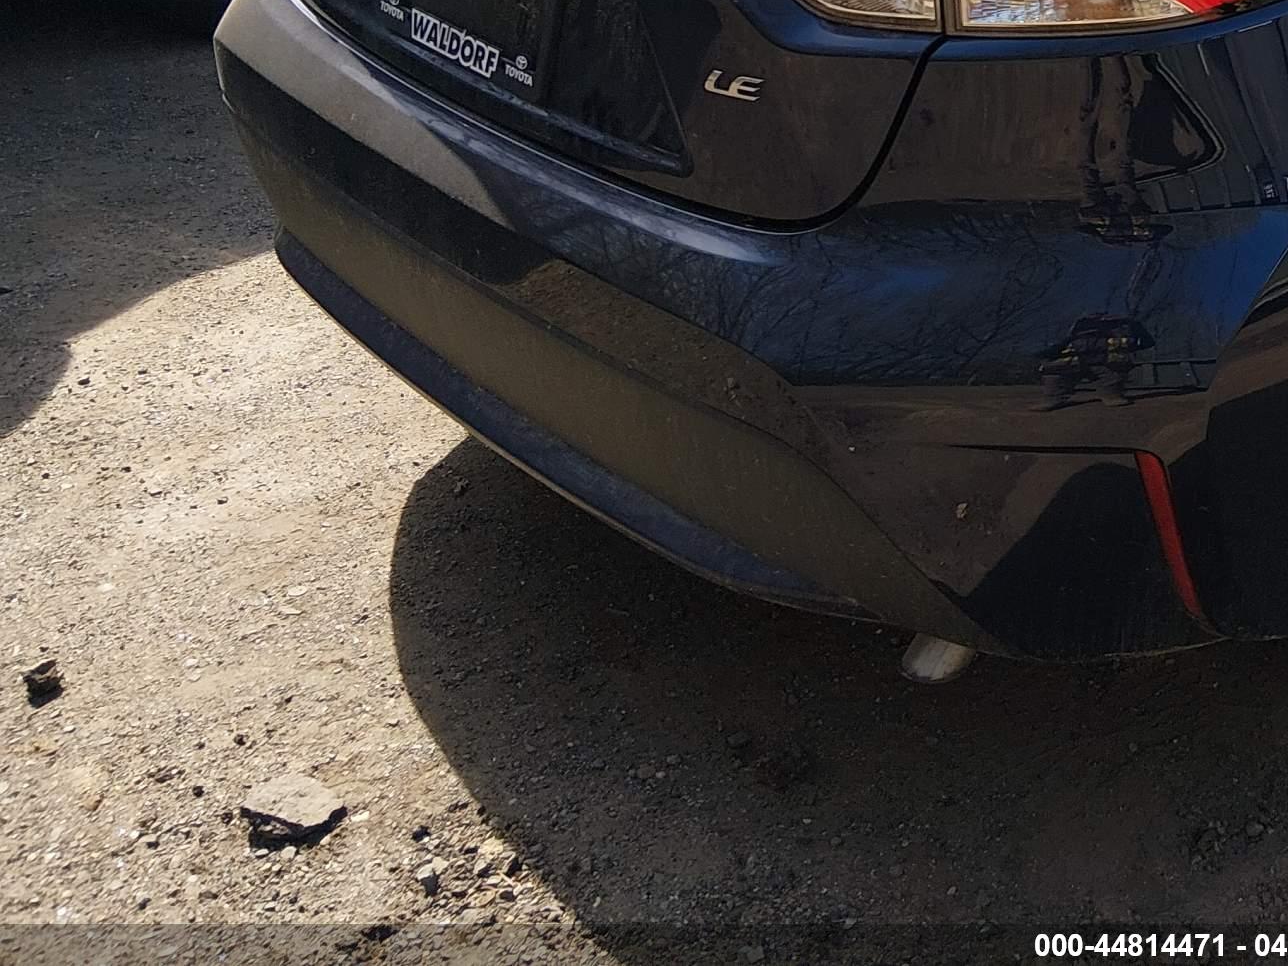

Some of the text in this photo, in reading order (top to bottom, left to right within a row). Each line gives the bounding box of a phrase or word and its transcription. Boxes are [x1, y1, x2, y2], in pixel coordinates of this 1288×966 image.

[379, 0, 534, 87] TOYOTA WALDORF TOYOTA
[704, 69, 766, 102] LE
